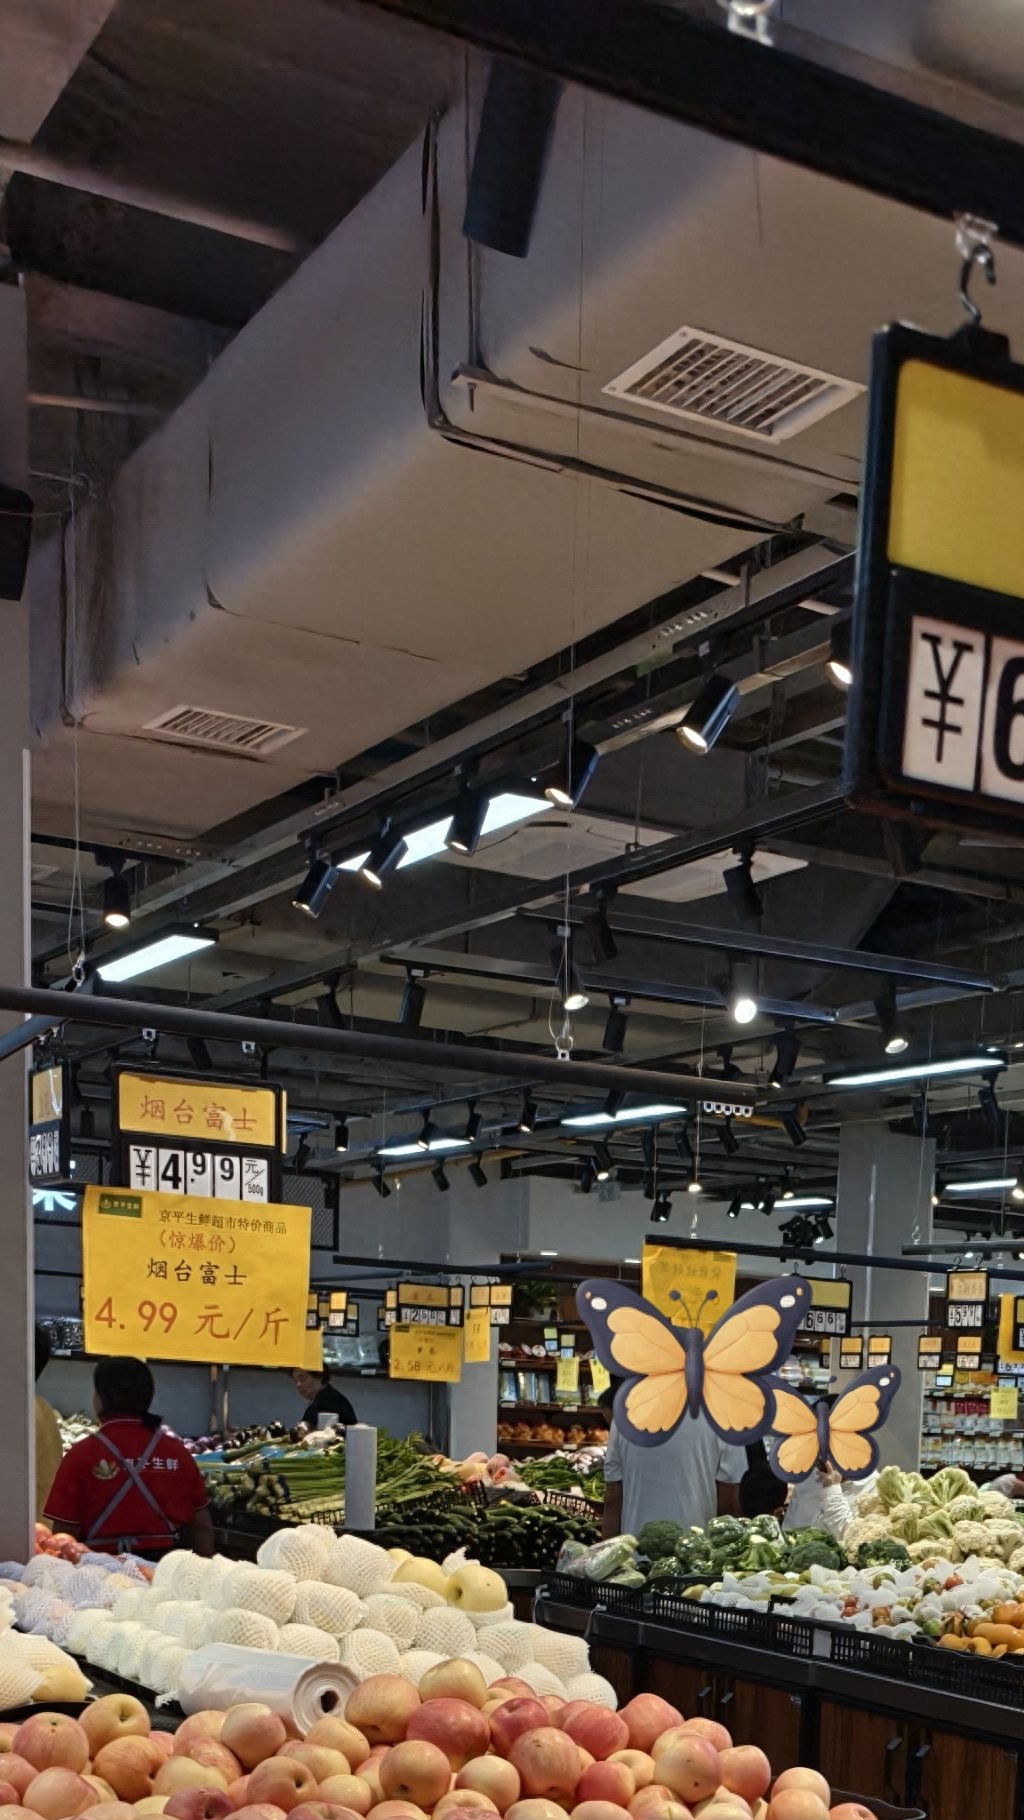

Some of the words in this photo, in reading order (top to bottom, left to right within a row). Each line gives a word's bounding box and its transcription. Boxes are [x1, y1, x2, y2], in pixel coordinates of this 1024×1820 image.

[140, 1095, 258, 1131] 烟台富士
[159, 1209, 287, 1234] 京平生鲜超市特价商品
[160, 1230, 237, 1254] （惊爆价）
[147, 1257, 247, 1286] 烟台富士
[94, 1296, 178, 1334] 4.99
[194, 1304, 290, 1345] 元/斤
